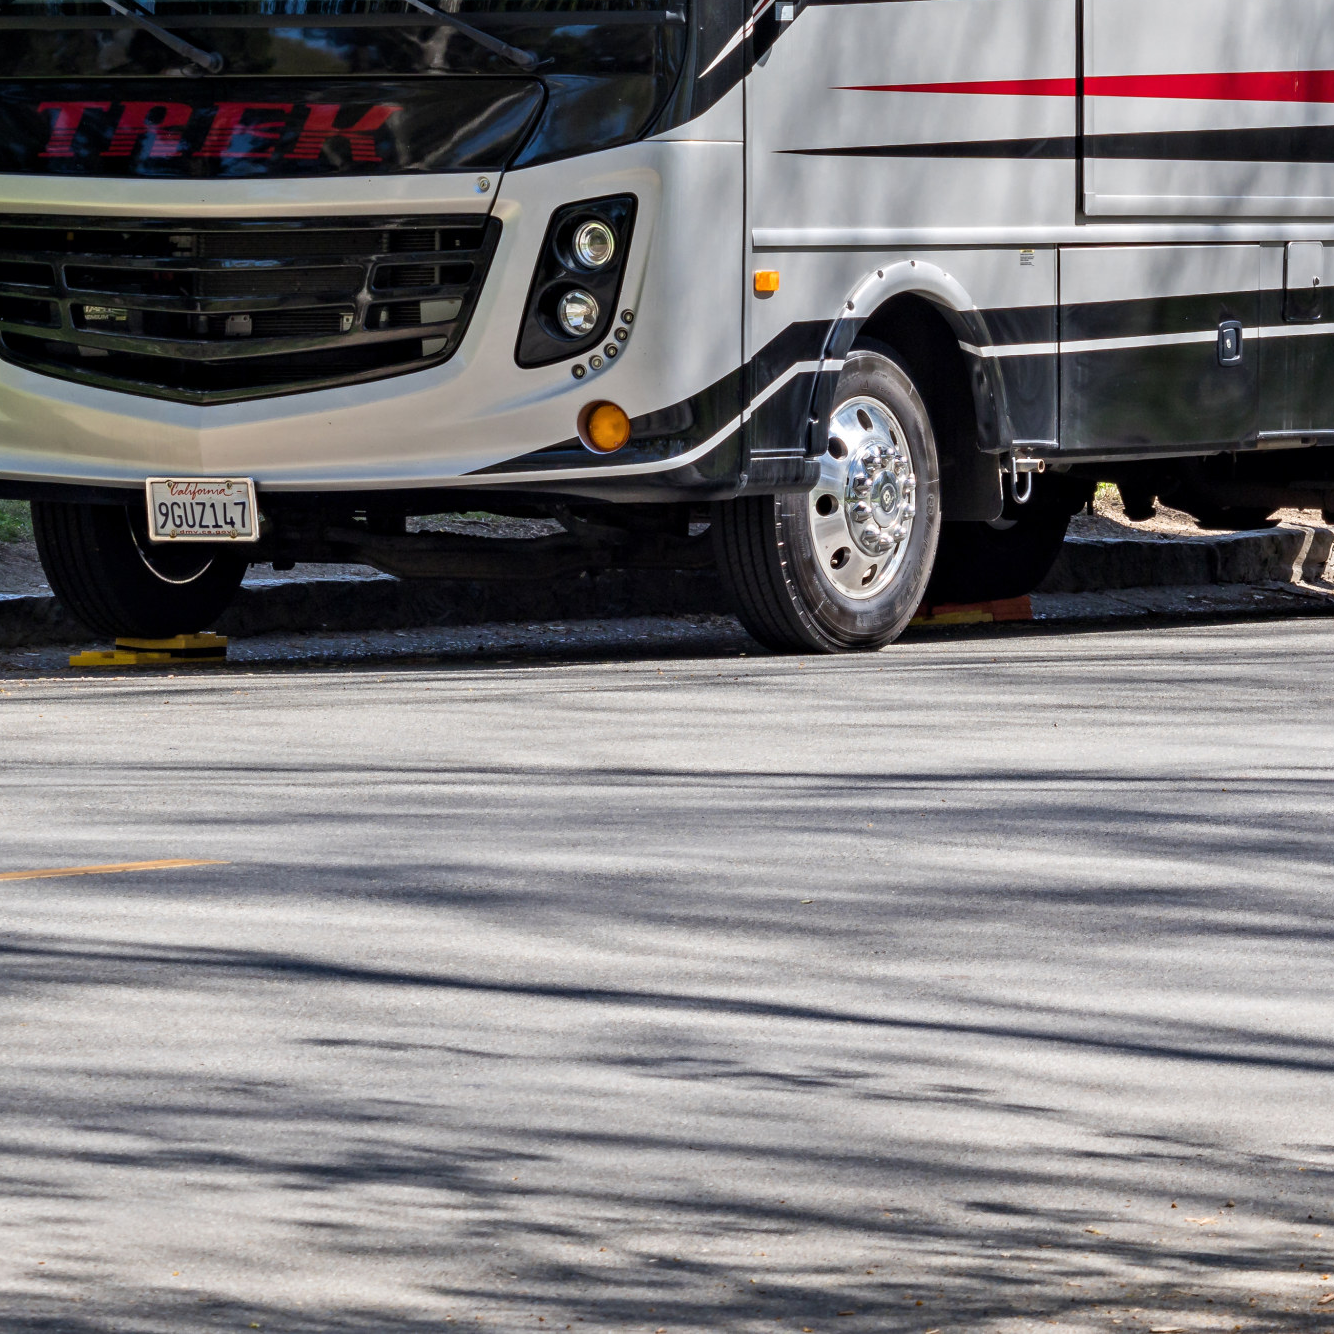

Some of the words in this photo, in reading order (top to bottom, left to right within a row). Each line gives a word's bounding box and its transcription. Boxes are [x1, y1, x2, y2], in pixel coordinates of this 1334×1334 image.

[37, 100, 403, 162] TREK
[170, 482, 233, 500] California
[158, 501, 246, 529] 9GUZ147
